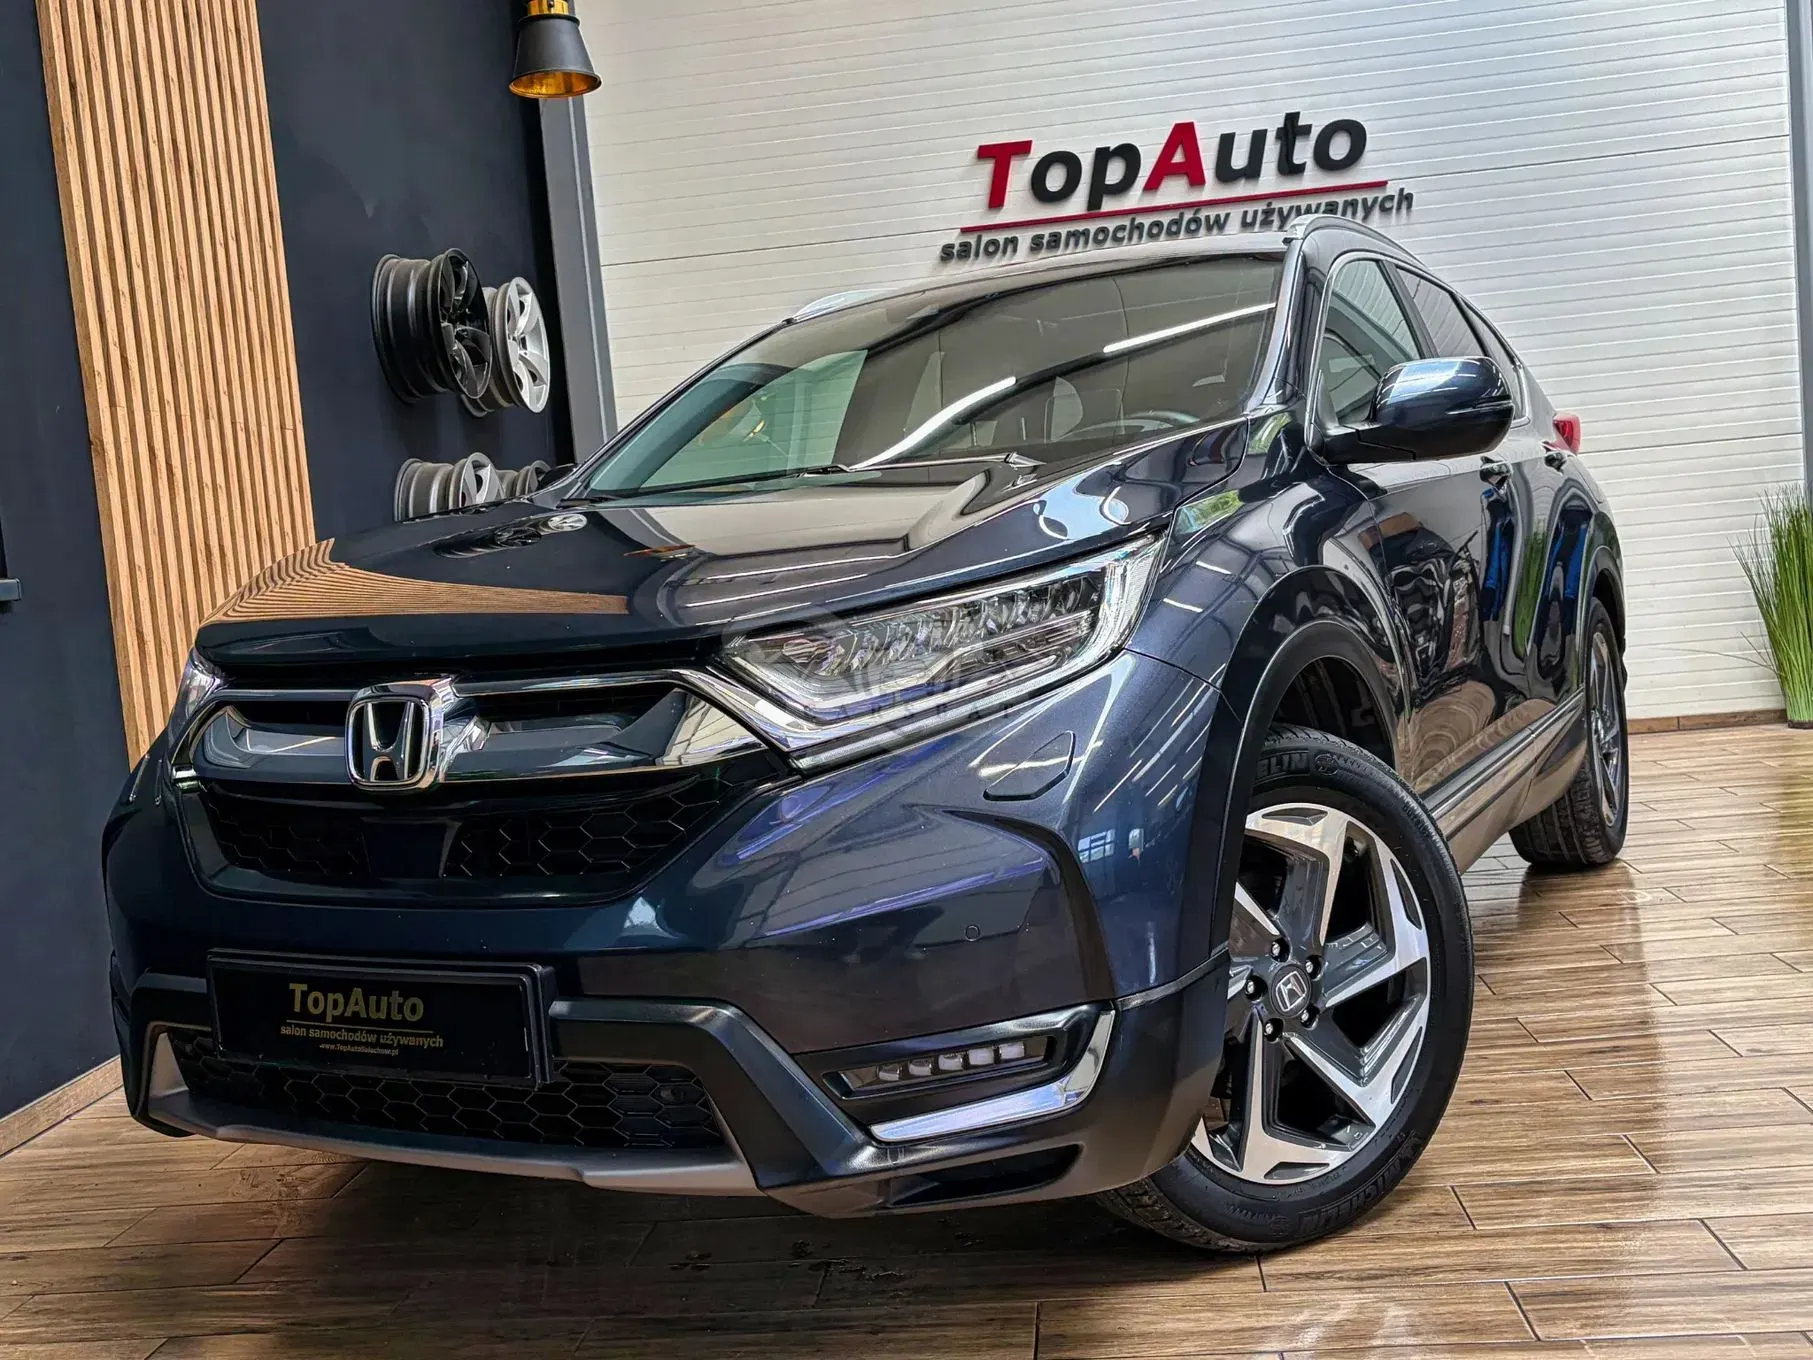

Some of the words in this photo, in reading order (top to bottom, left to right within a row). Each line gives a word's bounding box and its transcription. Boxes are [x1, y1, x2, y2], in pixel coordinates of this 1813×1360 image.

[977, 111, 1367, 211] TopAuto
[940, 233, 1019, 262] salon
[1030, 208, 1231, 250] samochodów
[1240, 187, 1414, 230] używanych
[289, 983, 424, 1022] TopAuto
[280, 1024, 306, 1037] salon
[308, 1026, 377, 1043] samochodów
[379, 1031, 443, 1049] używanych
